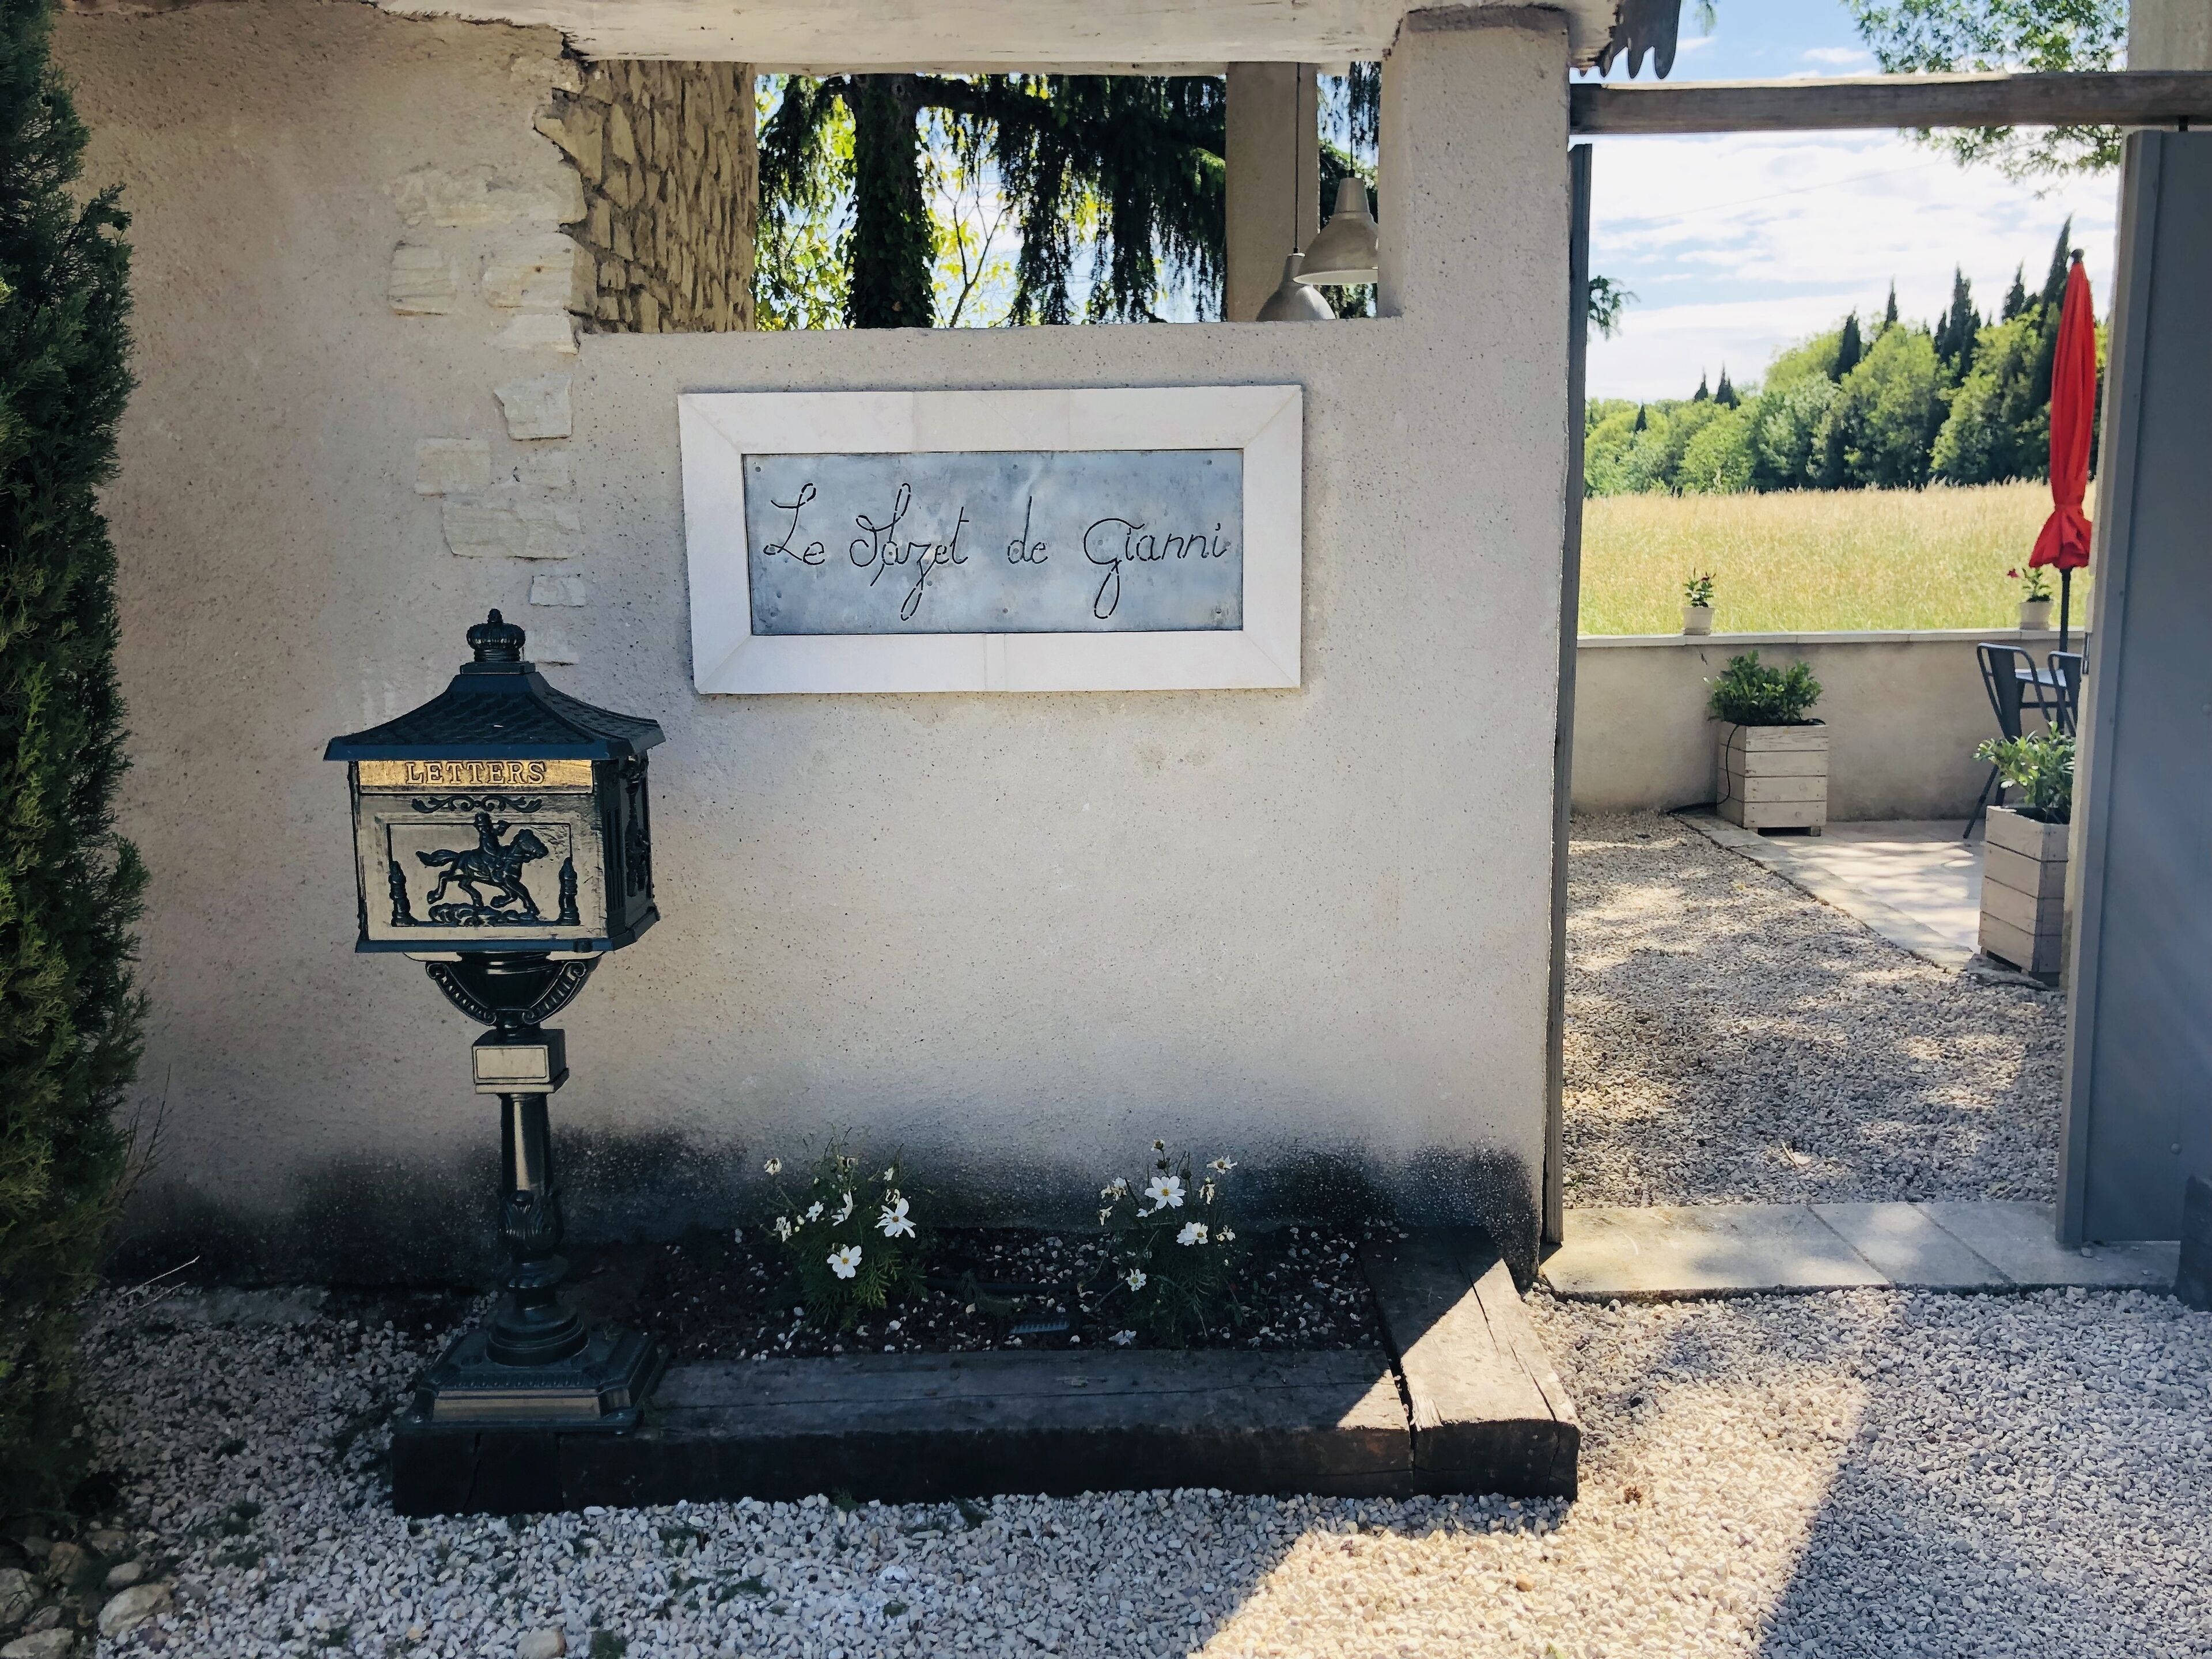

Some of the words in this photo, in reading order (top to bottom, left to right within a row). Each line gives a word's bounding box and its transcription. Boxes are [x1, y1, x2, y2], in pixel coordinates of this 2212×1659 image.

[763, 482, 826, 566] Le
[1006, 495, 1048, 565] de
[1083, 517, 1228, 620] Gianni
[404, 761, 547, 785] LETTERS
